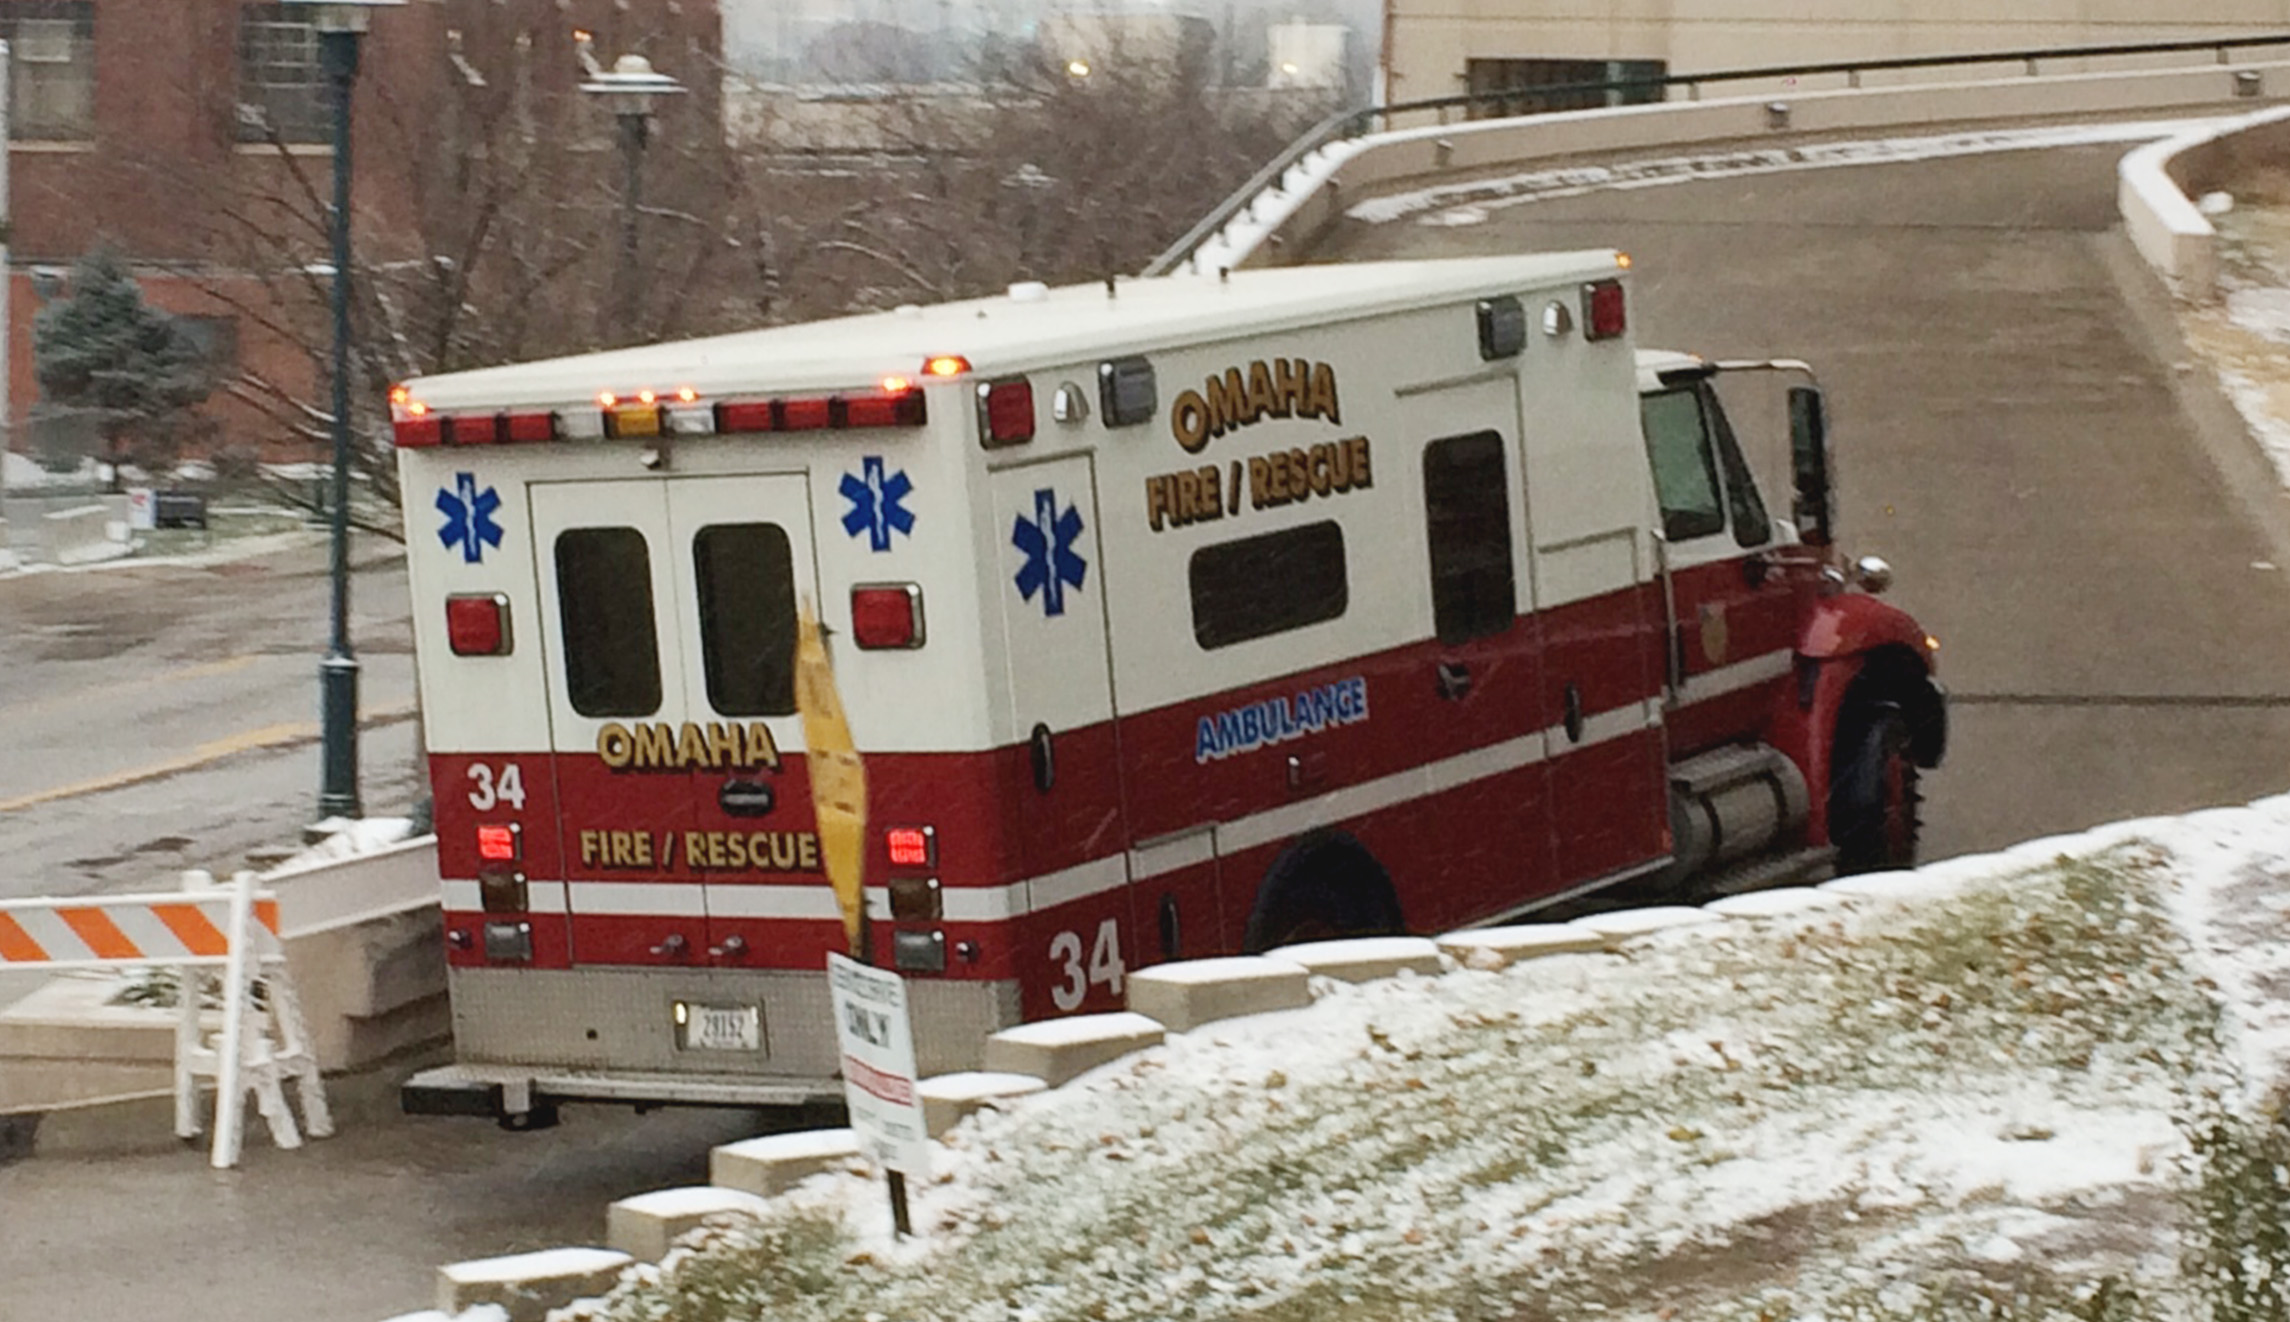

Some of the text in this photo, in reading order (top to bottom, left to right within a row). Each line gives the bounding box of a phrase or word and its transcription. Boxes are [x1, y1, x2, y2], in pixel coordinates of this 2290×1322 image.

[1172, 358, 1341, 453] OMAHA
[1146, 466, 1223, 531] FIRE
[1248, 436, 1373, 510] RESCUE
[597, 722, 780, 771] OMAHA
[1195, 677, 1368, 763] AMBULANCE
[466, 763, 526, 810] 34
[580, 830, 653, 870] FIRE
[685, 830, 818, 870] RESCUE
[1050, 918, 1126, 1012] 34
